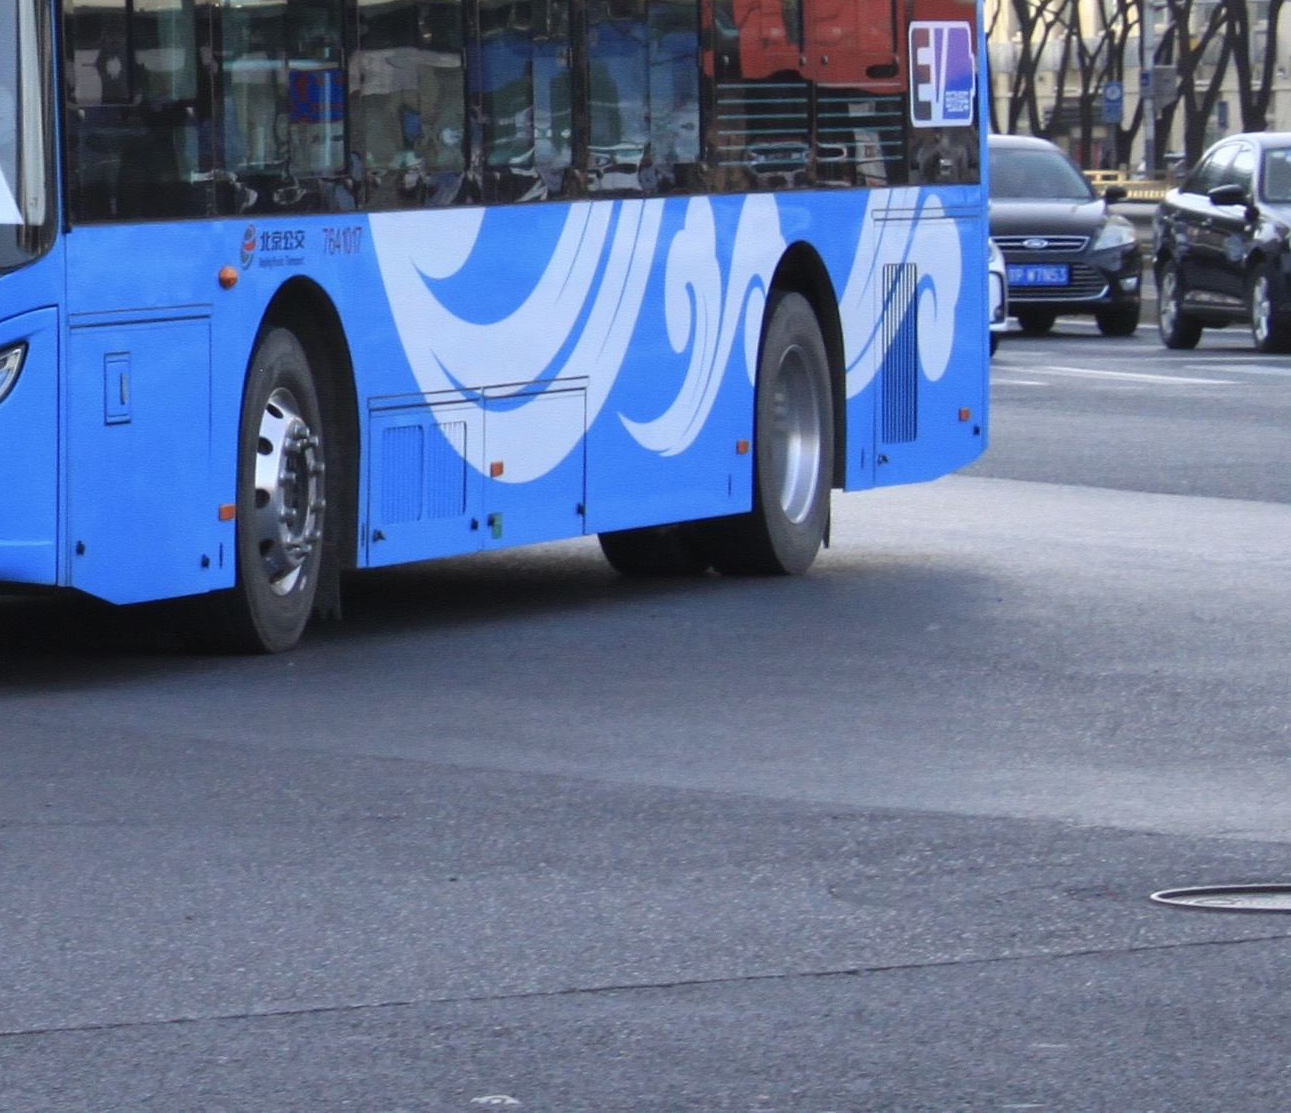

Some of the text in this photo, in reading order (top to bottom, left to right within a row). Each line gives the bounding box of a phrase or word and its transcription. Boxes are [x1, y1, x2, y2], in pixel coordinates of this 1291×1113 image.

[259, 229, 306, 252] 北京公交
[323, 225, 362, 255] 7641017
